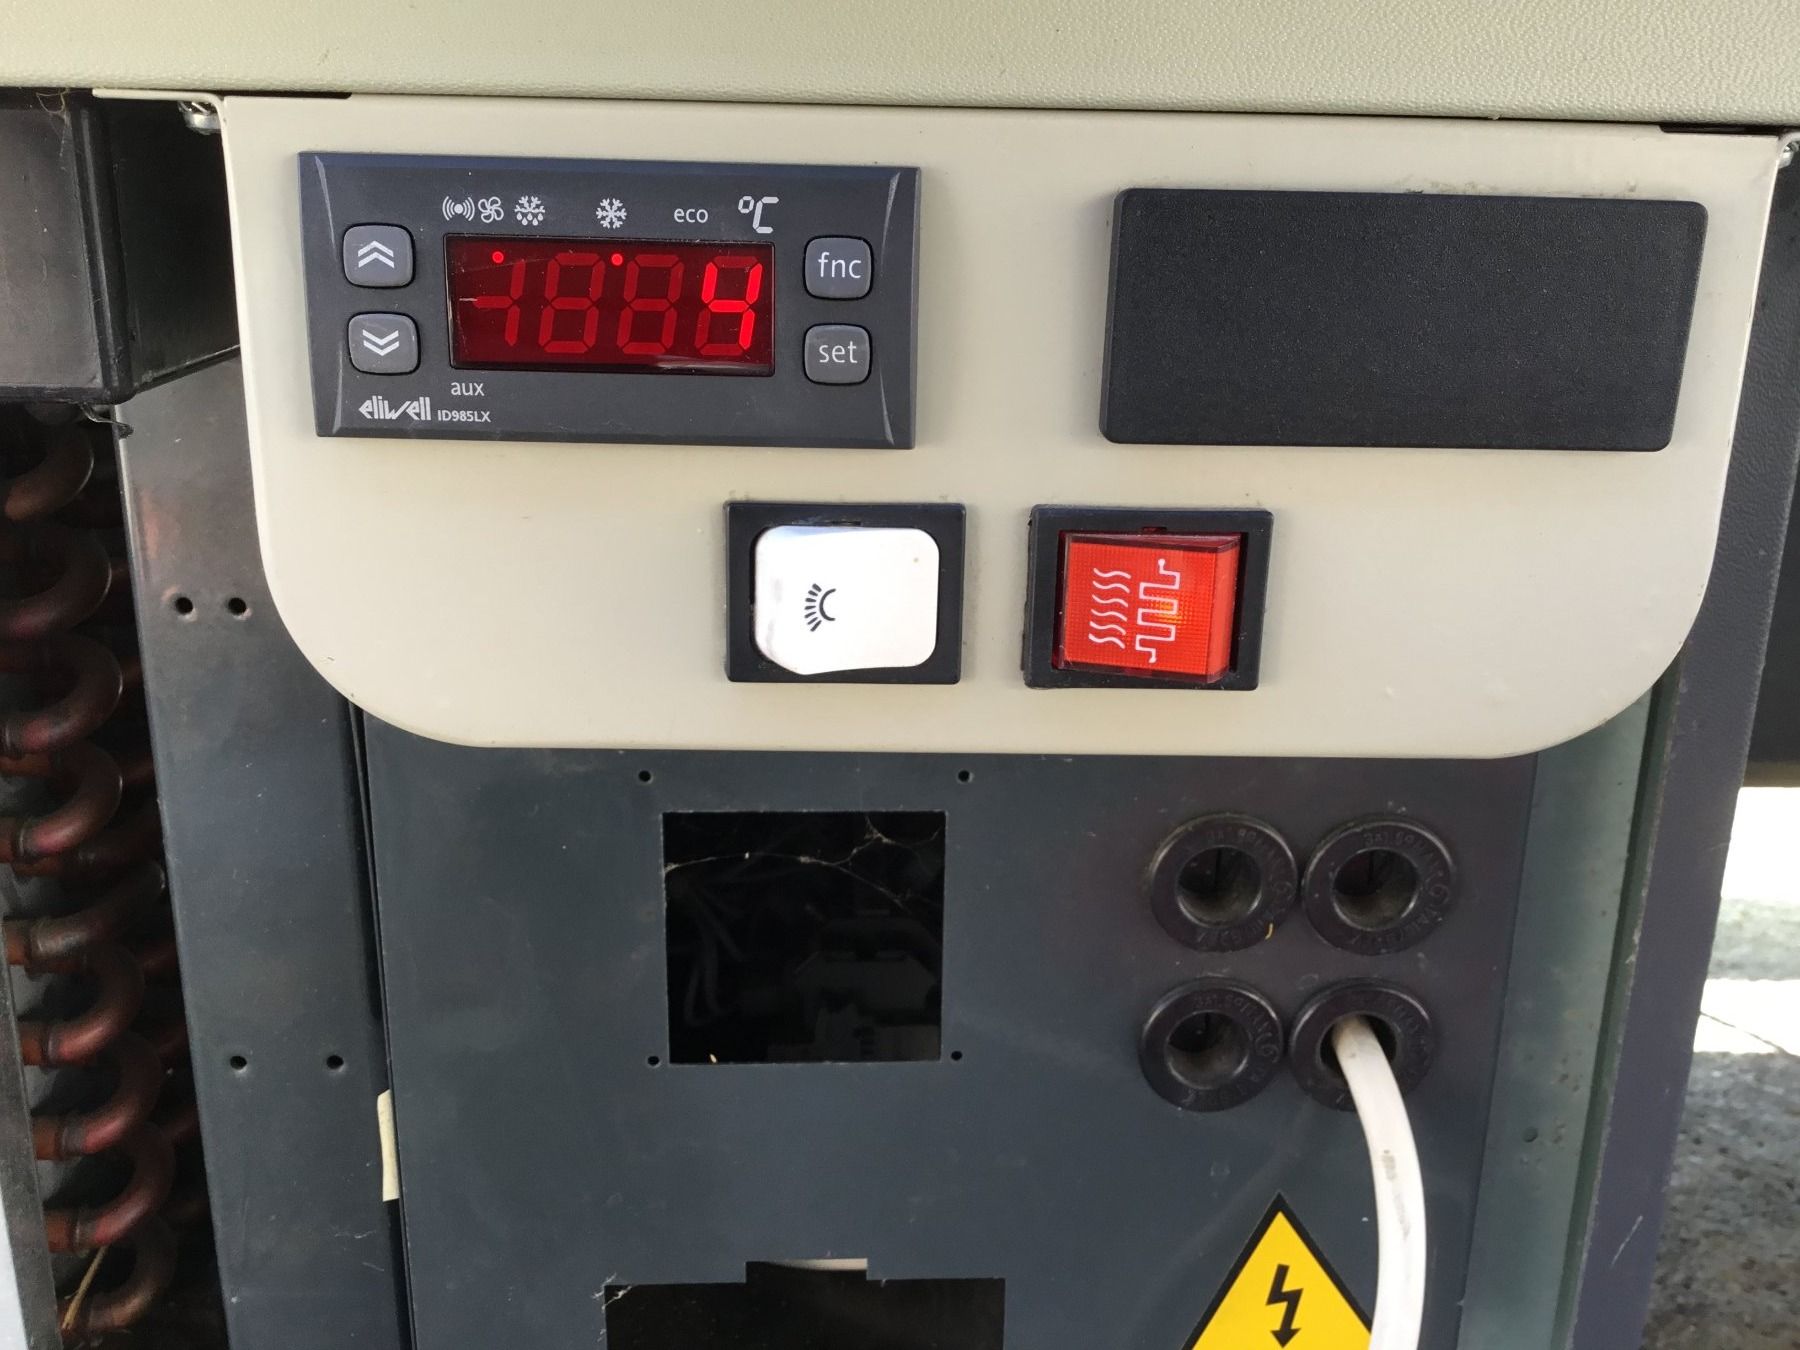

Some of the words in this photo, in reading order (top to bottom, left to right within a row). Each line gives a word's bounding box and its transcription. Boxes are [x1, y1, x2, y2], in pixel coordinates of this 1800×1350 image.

[673, 208, 709, 224] eco
[817, 251, 862, 279] fnc
[818, 340, 858, 364] set
[450, 381, 485, 397] aux
[358, 395, 432, 421] eliwell
[437, 409, 492, 423] ID985LX
